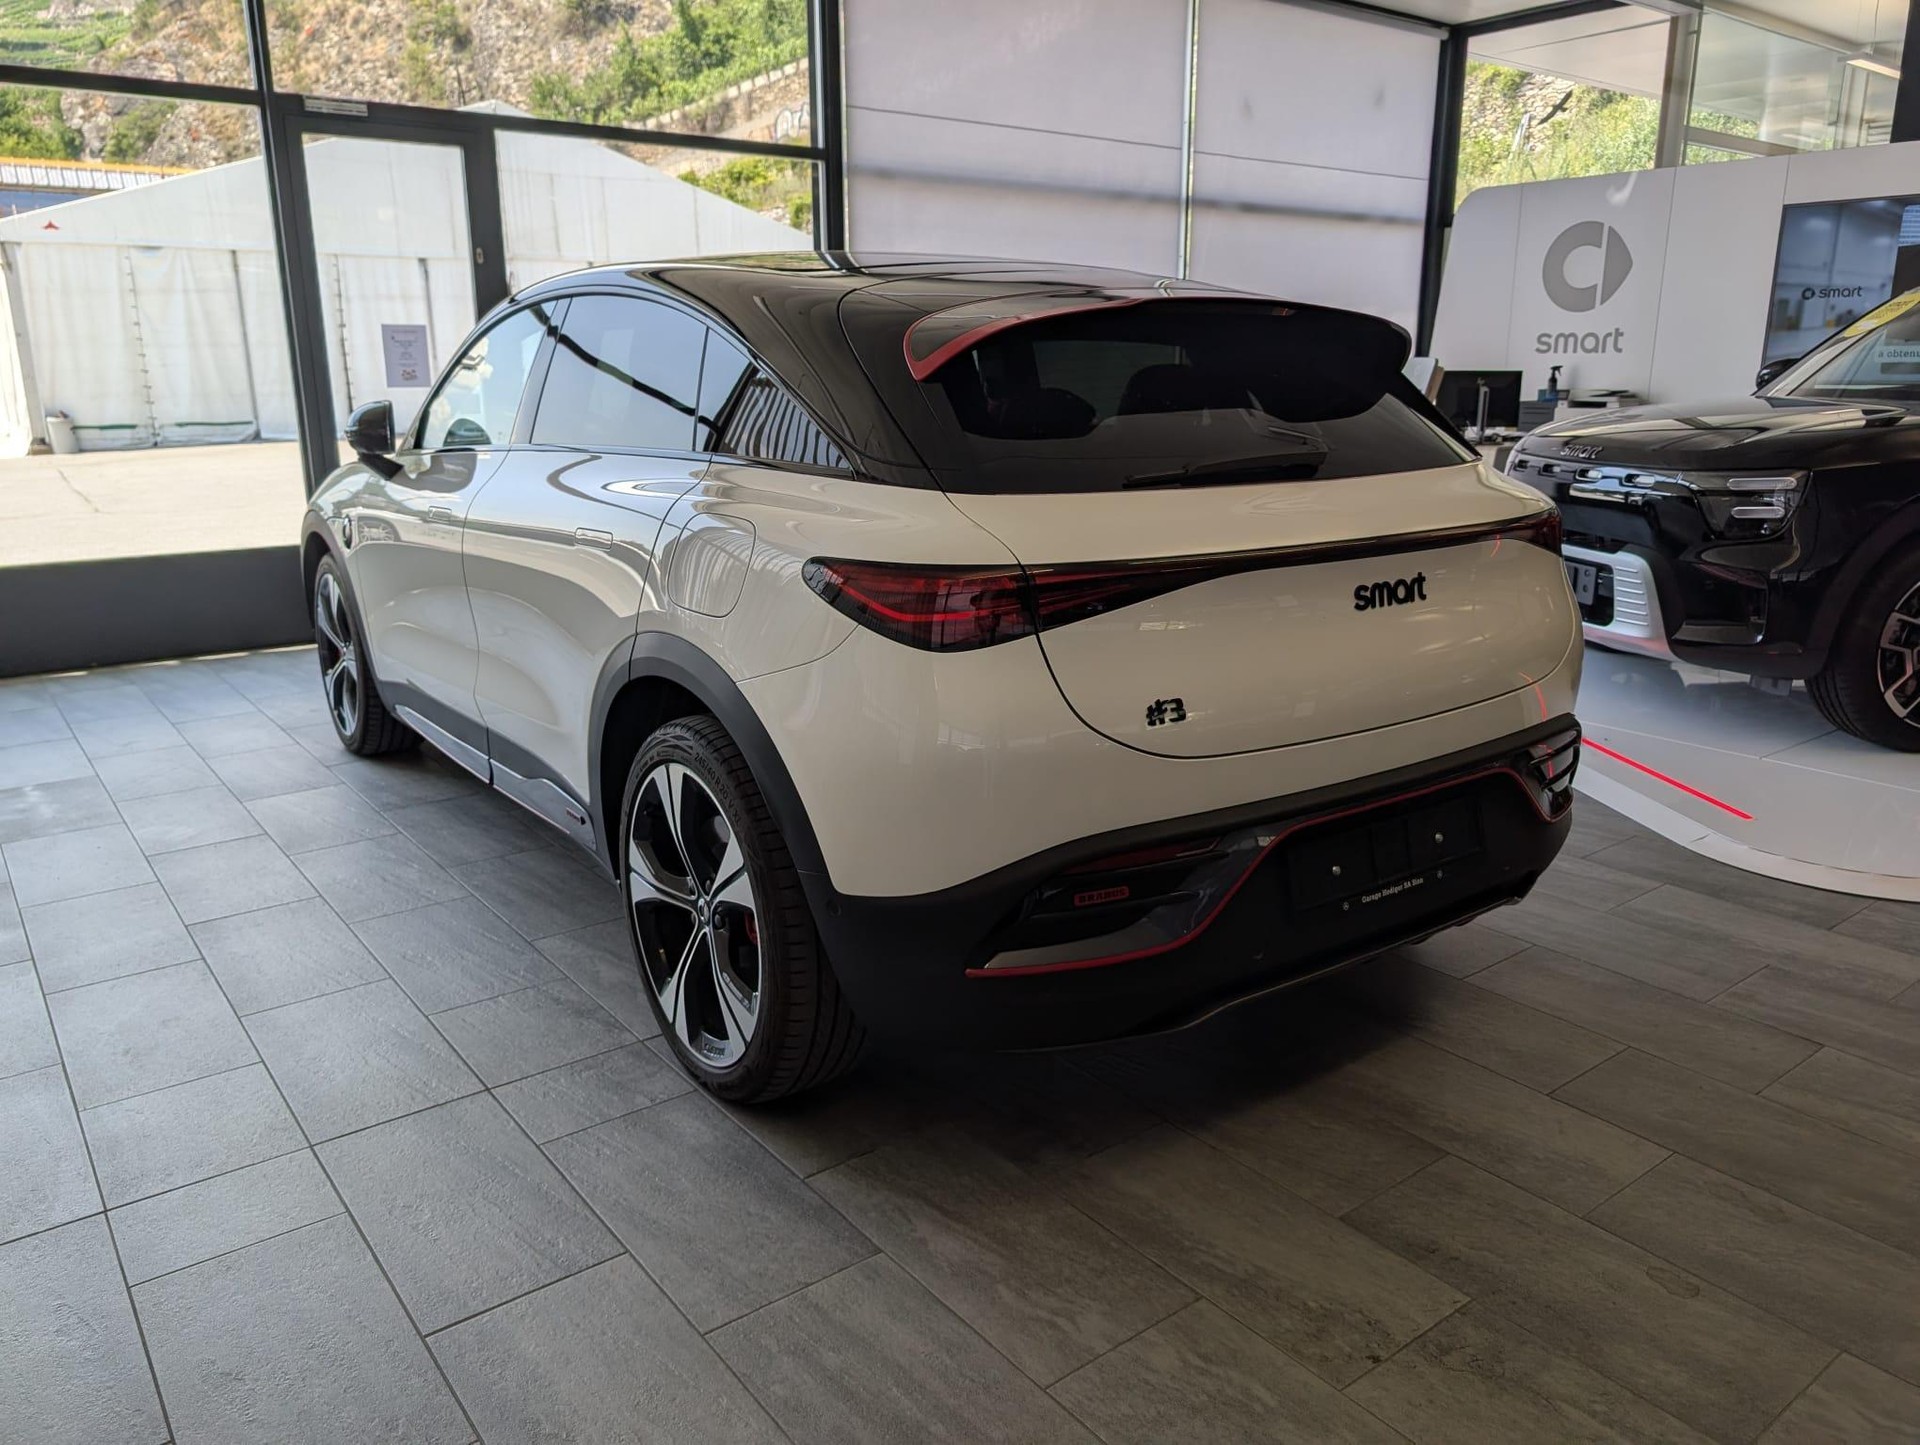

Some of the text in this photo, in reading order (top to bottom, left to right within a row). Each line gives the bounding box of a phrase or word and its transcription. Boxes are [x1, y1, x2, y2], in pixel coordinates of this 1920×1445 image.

[1818, 286, 1863, 299] smart
[1535, 327, 1624, 354] smart
[1561, 444, 1603, 459] smart
[1354, 572, 1427, 611] smart
[1146, 698, 1186, 726] #3
[1078, 888, 1126, 904] BRABUS
[1361, 893, 1381, 903] Garage
